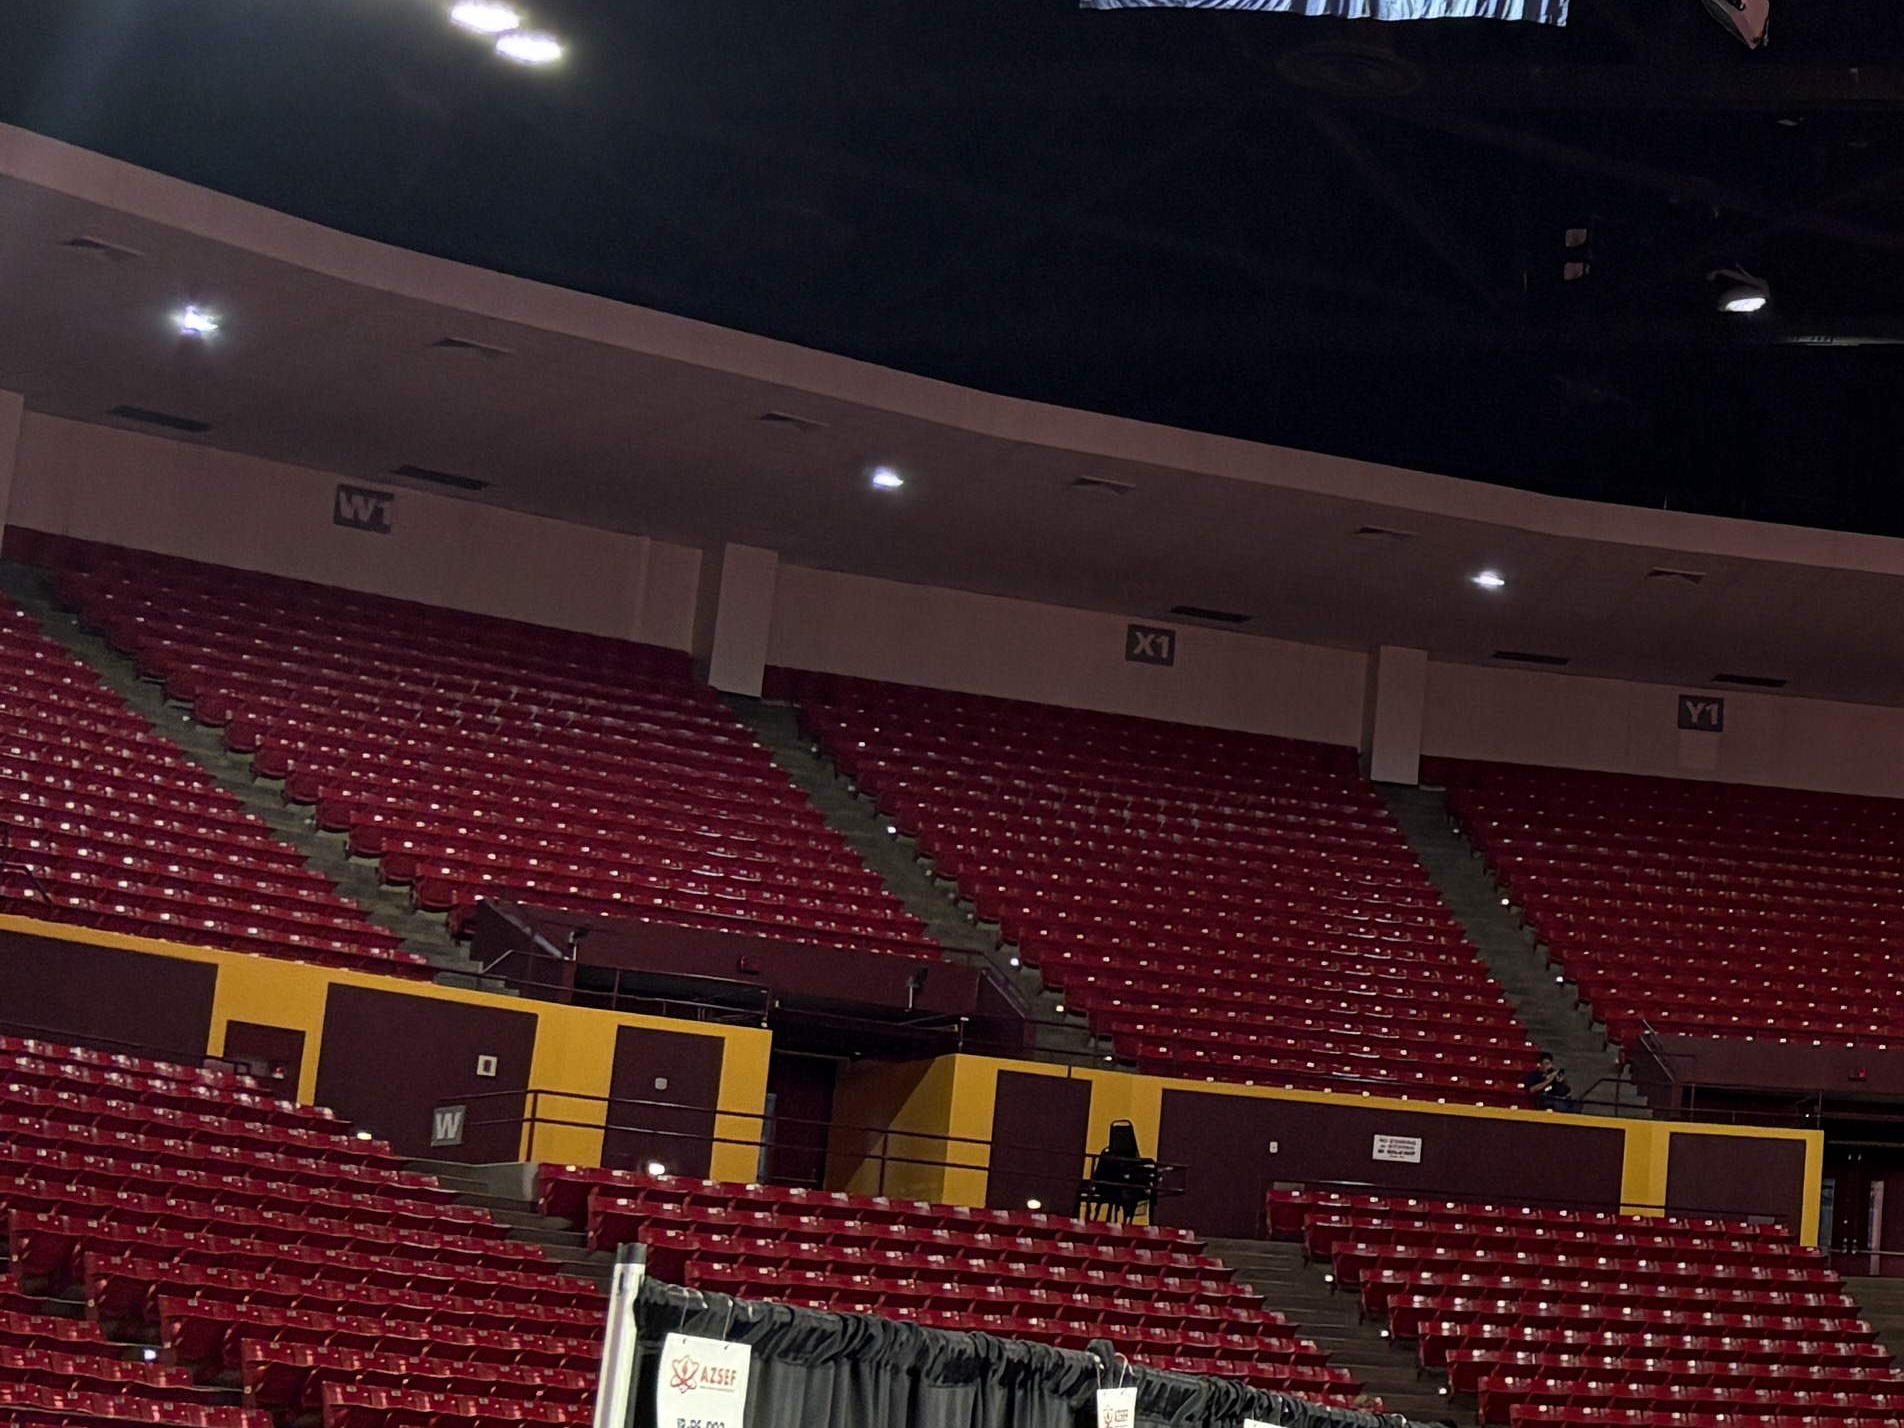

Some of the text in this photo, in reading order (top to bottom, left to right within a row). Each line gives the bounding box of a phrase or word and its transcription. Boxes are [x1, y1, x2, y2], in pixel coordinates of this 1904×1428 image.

[339, 492, 393, 526] W1
[1133, 632, 1170, 659] X1
[1686, 701, 1721, 725] Y1
[434, 1113, 464, 1142] W
[700, 1367, 737, 1386] AZSEF
